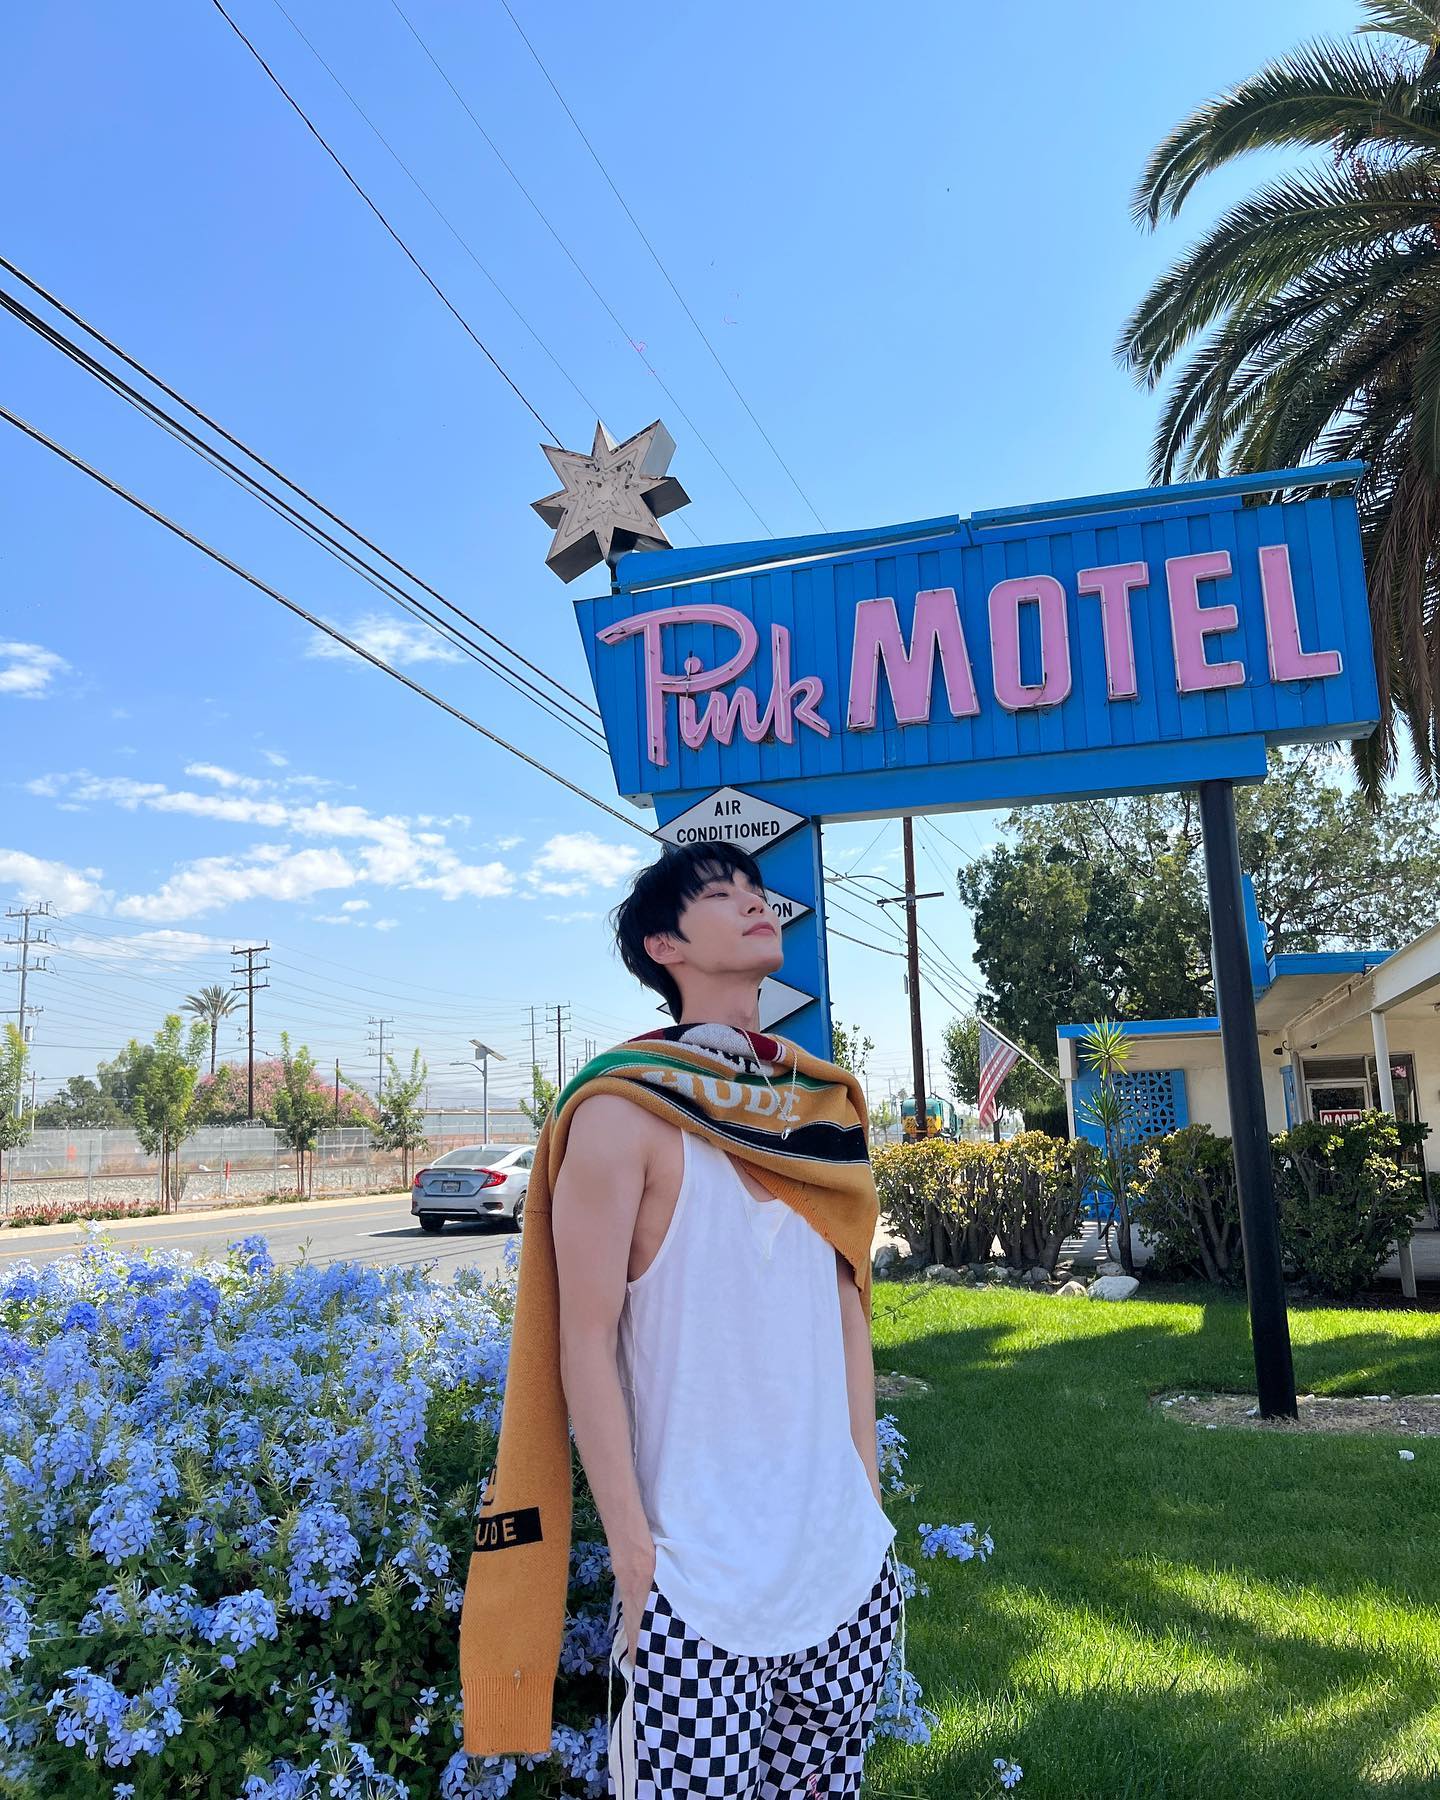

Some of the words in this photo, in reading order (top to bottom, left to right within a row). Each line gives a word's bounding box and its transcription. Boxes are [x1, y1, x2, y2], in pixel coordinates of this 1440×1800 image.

[595, 604, 830, 767] Pink
[847, 543, 1343, 732] MOTEL
[714, 800, 742, 816] AIR
[676, 820, 780, 843] CONDITIONED
